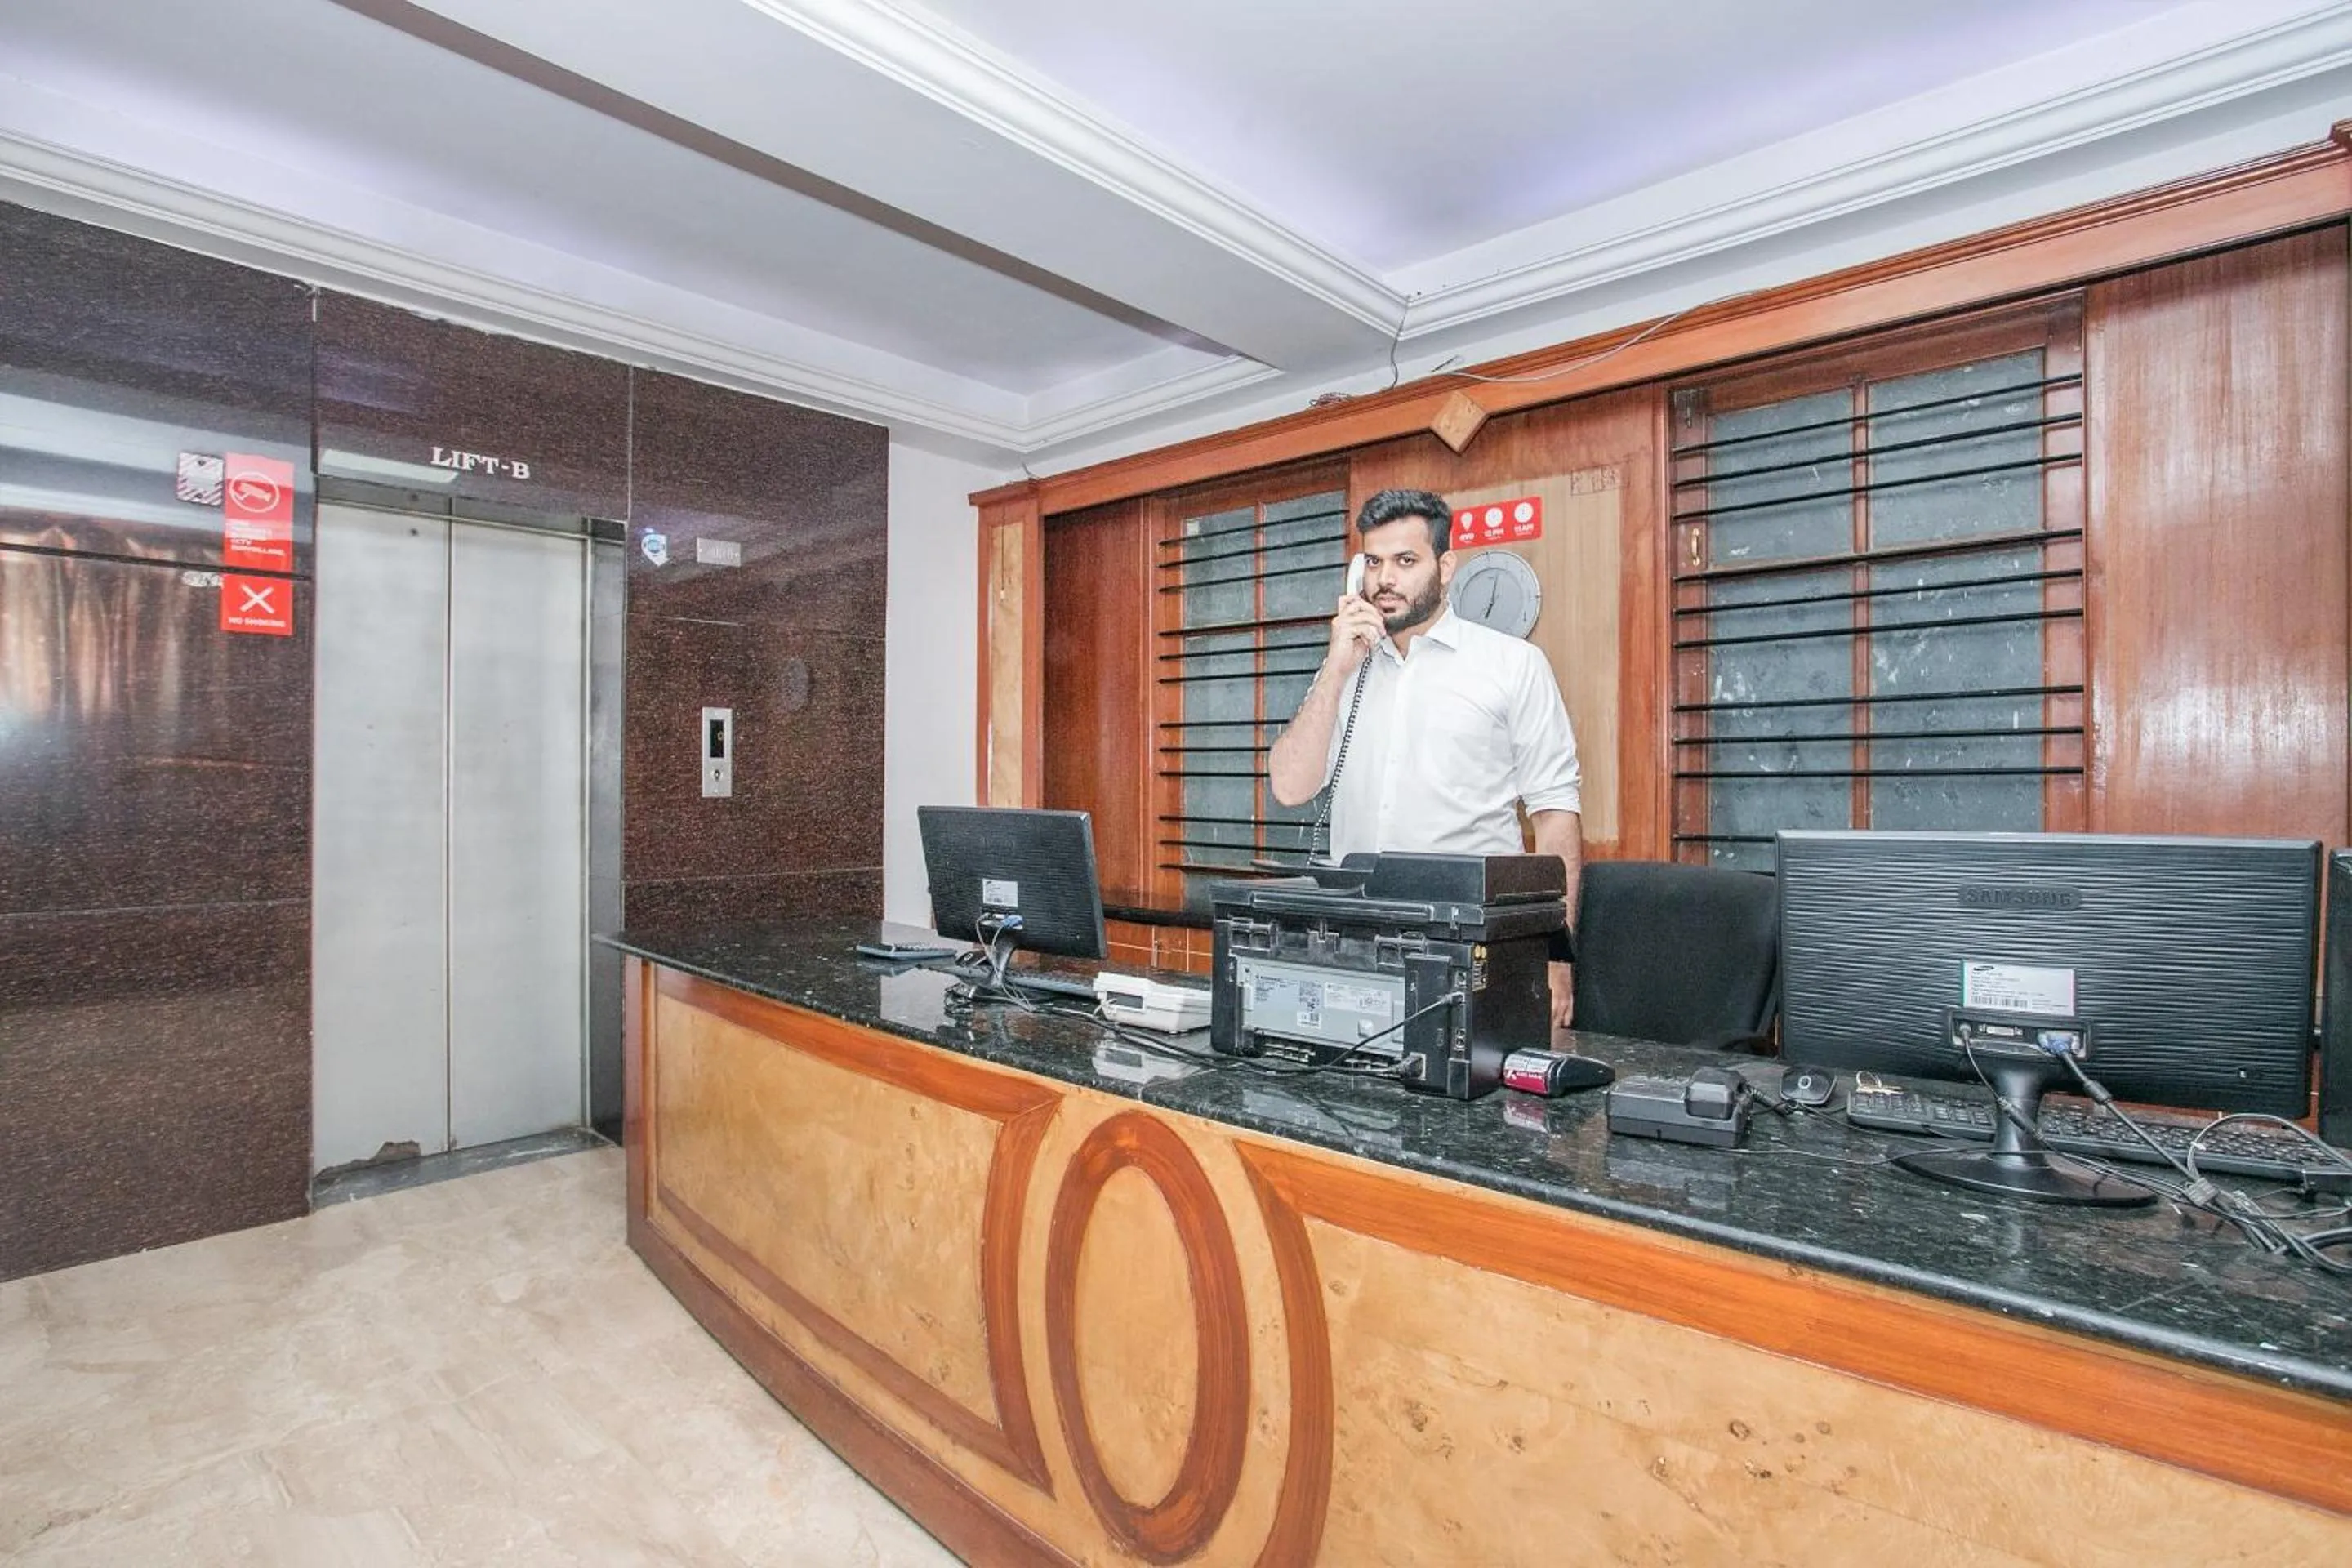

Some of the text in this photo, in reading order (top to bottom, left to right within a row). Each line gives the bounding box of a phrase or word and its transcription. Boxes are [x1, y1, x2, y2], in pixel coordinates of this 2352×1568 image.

[430, 446, 530, 479] LIFT-B
[228, 617, 286, 628] NO SMOKING
[1966, 887, 2072, 906] SAMSUNG
